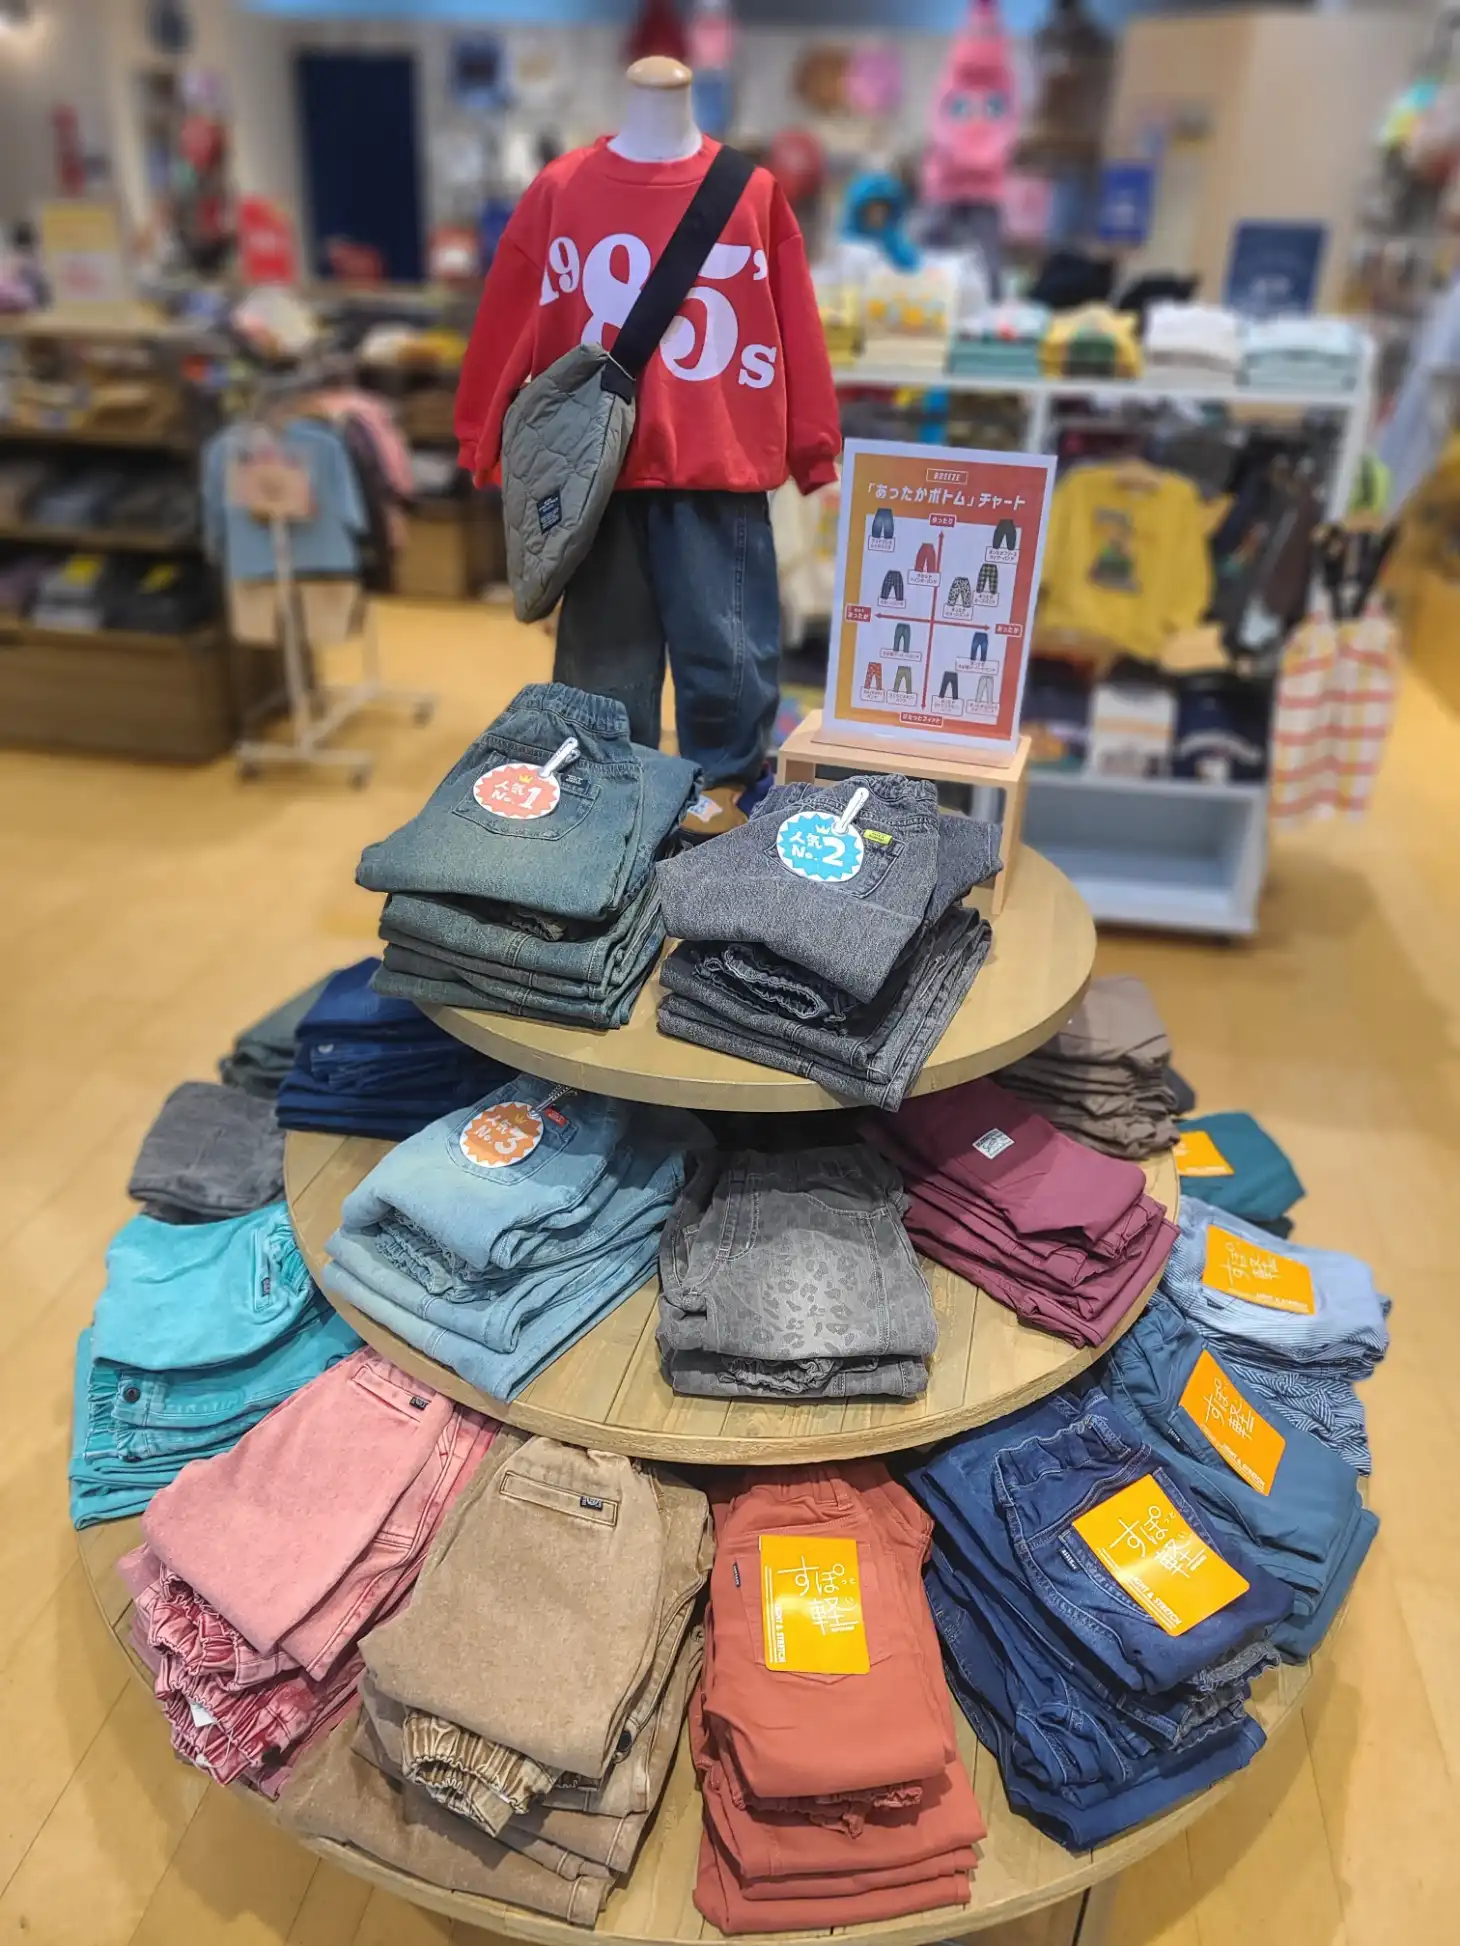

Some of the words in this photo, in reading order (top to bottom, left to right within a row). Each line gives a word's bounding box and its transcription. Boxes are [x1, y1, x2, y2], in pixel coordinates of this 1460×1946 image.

[932, 516, 954, 525] ゆったり
[494, 781, 525, 795] 人気
[789, 831, 822, 849] 人気
[486, 1115, 512, 1134] 人気
